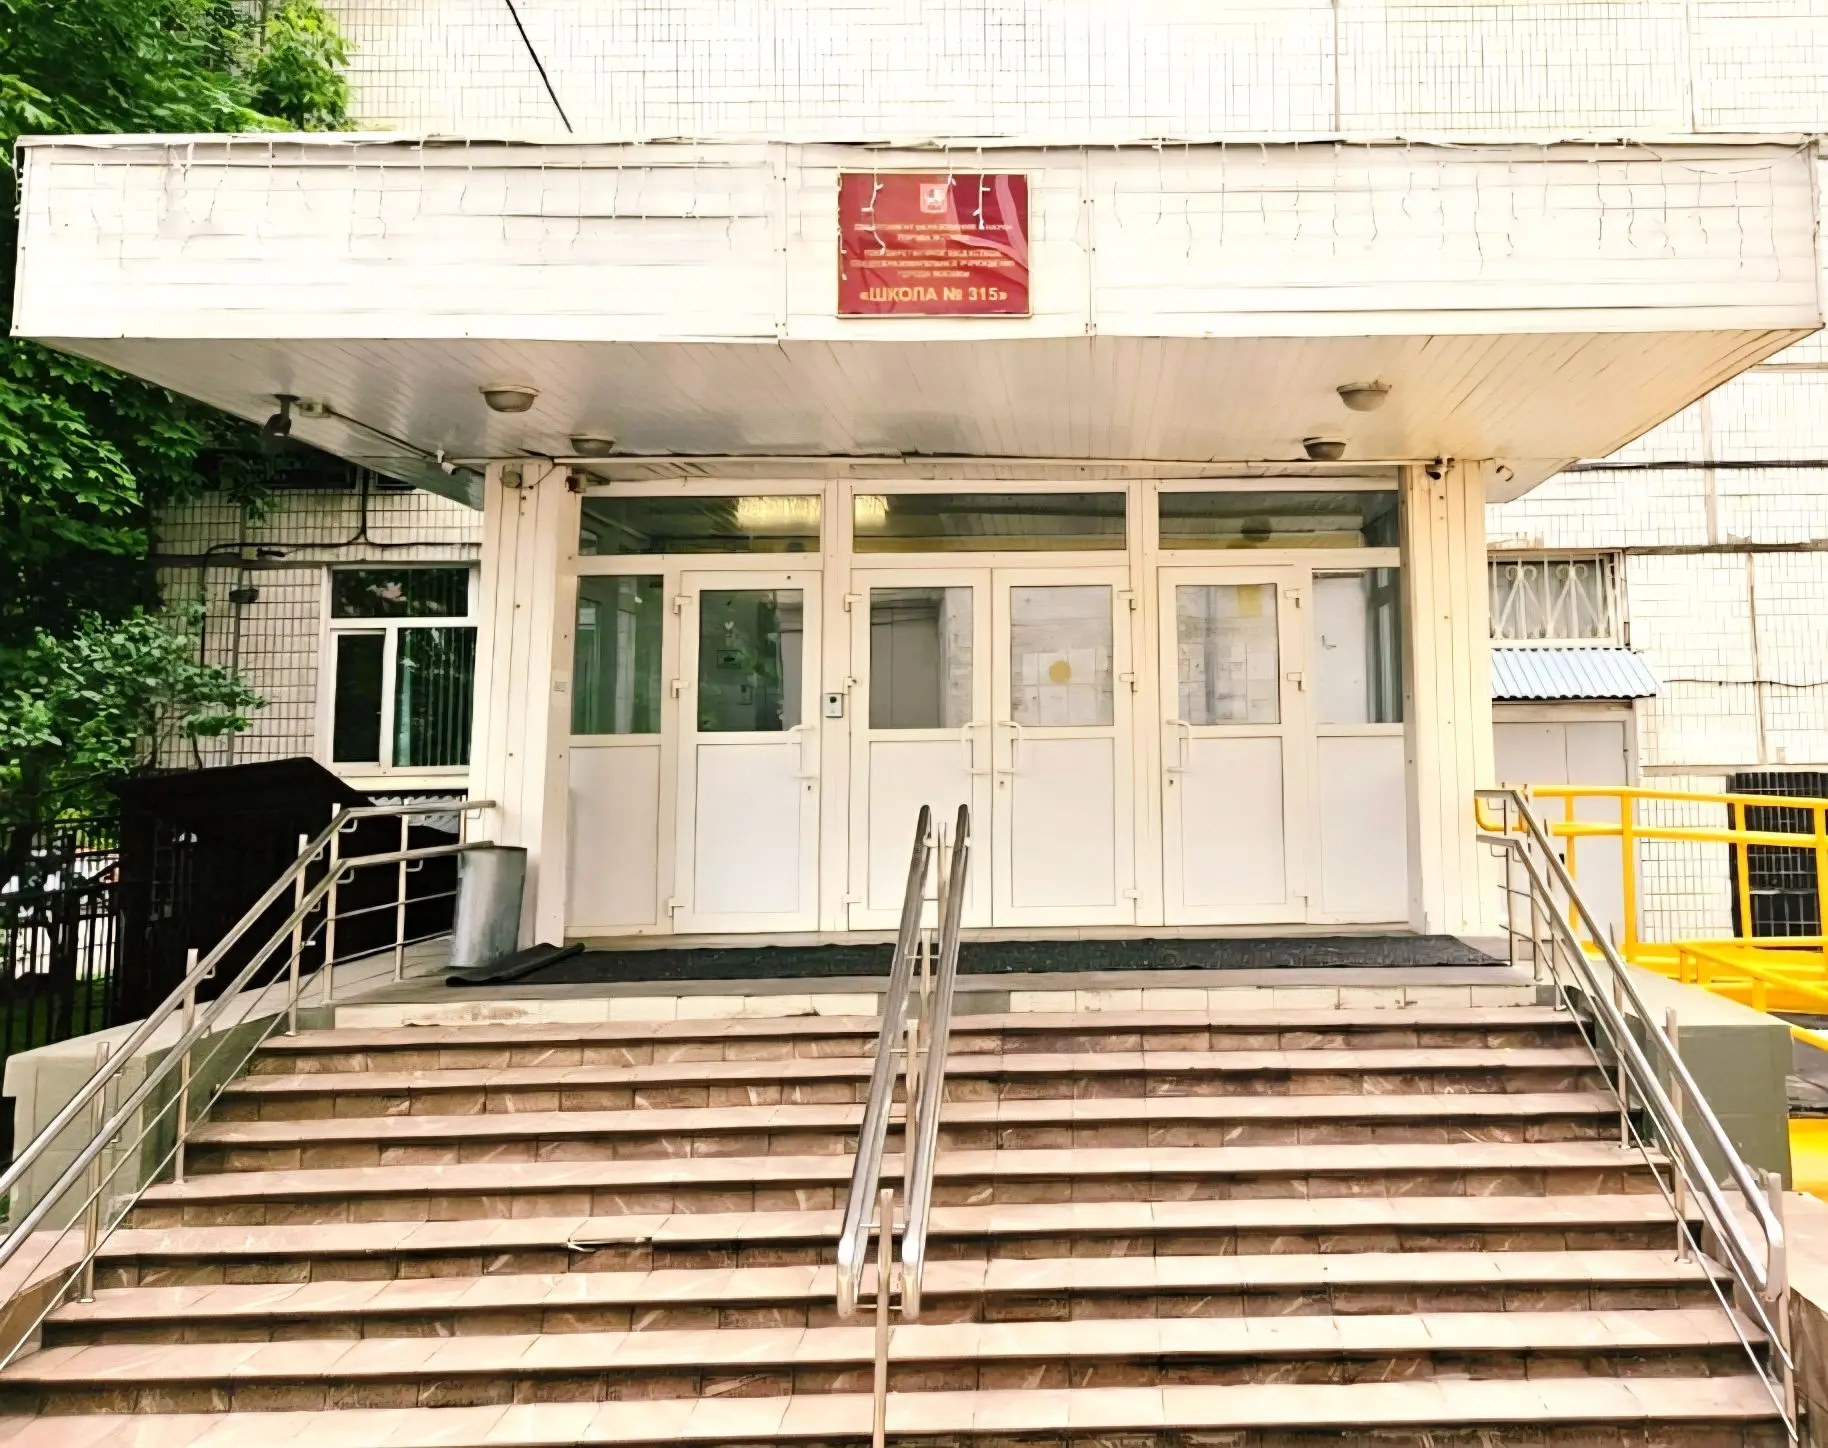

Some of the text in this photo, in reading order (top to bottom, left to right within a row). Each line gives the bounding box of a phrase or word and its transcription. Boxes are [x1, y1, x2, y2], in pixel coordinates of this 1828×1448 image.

[859, 286, 1008, 302] «ШКОЛА № 315»
